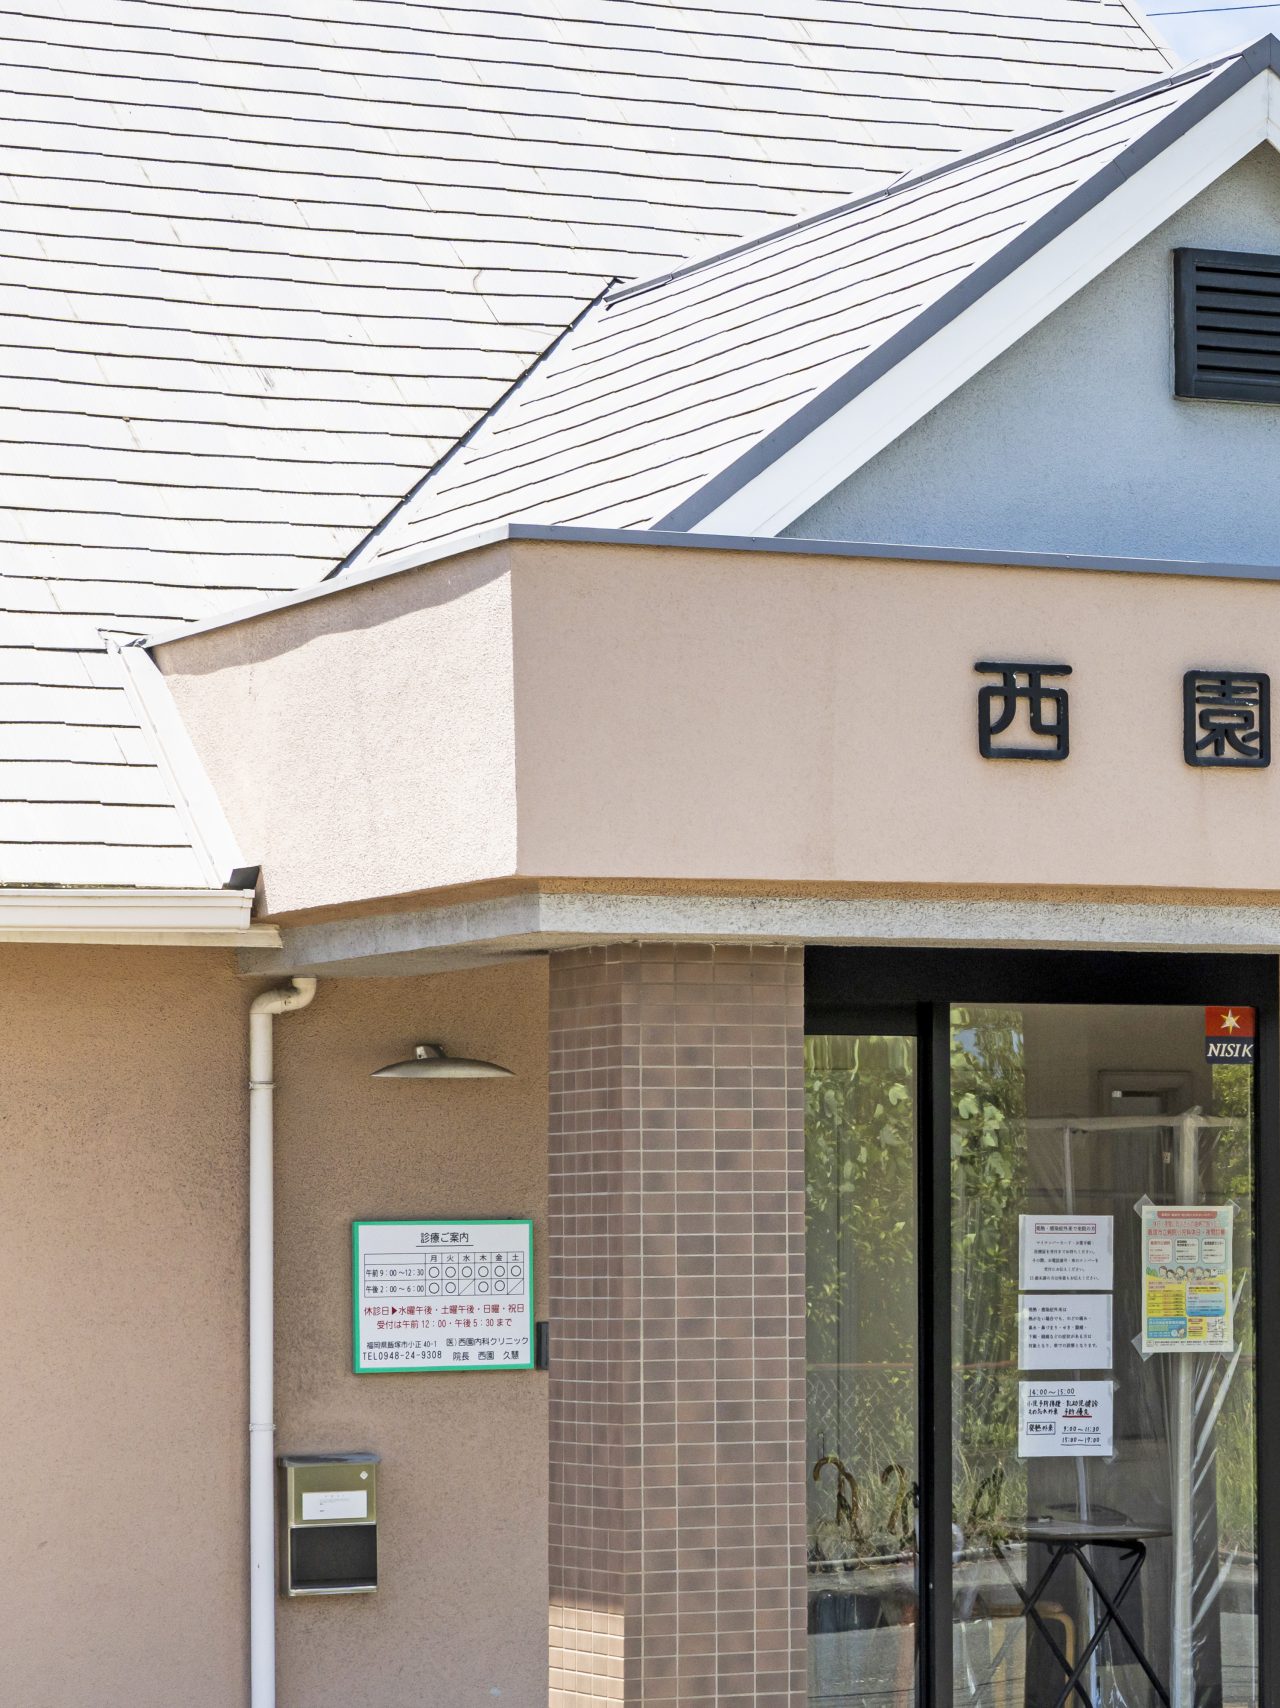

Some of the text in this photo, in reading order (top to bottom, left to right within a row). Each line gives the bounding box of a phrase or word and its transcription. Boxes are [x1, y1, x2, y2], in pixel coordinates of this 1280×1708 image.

[420, 1232, 469, 1244] 診療ご案内
[430, 1253, 519, 1263] 月 火 水 木 金 土
[452, 1351, 470, 1361] 院長
[477, 1351, 495, 1360] 西園
